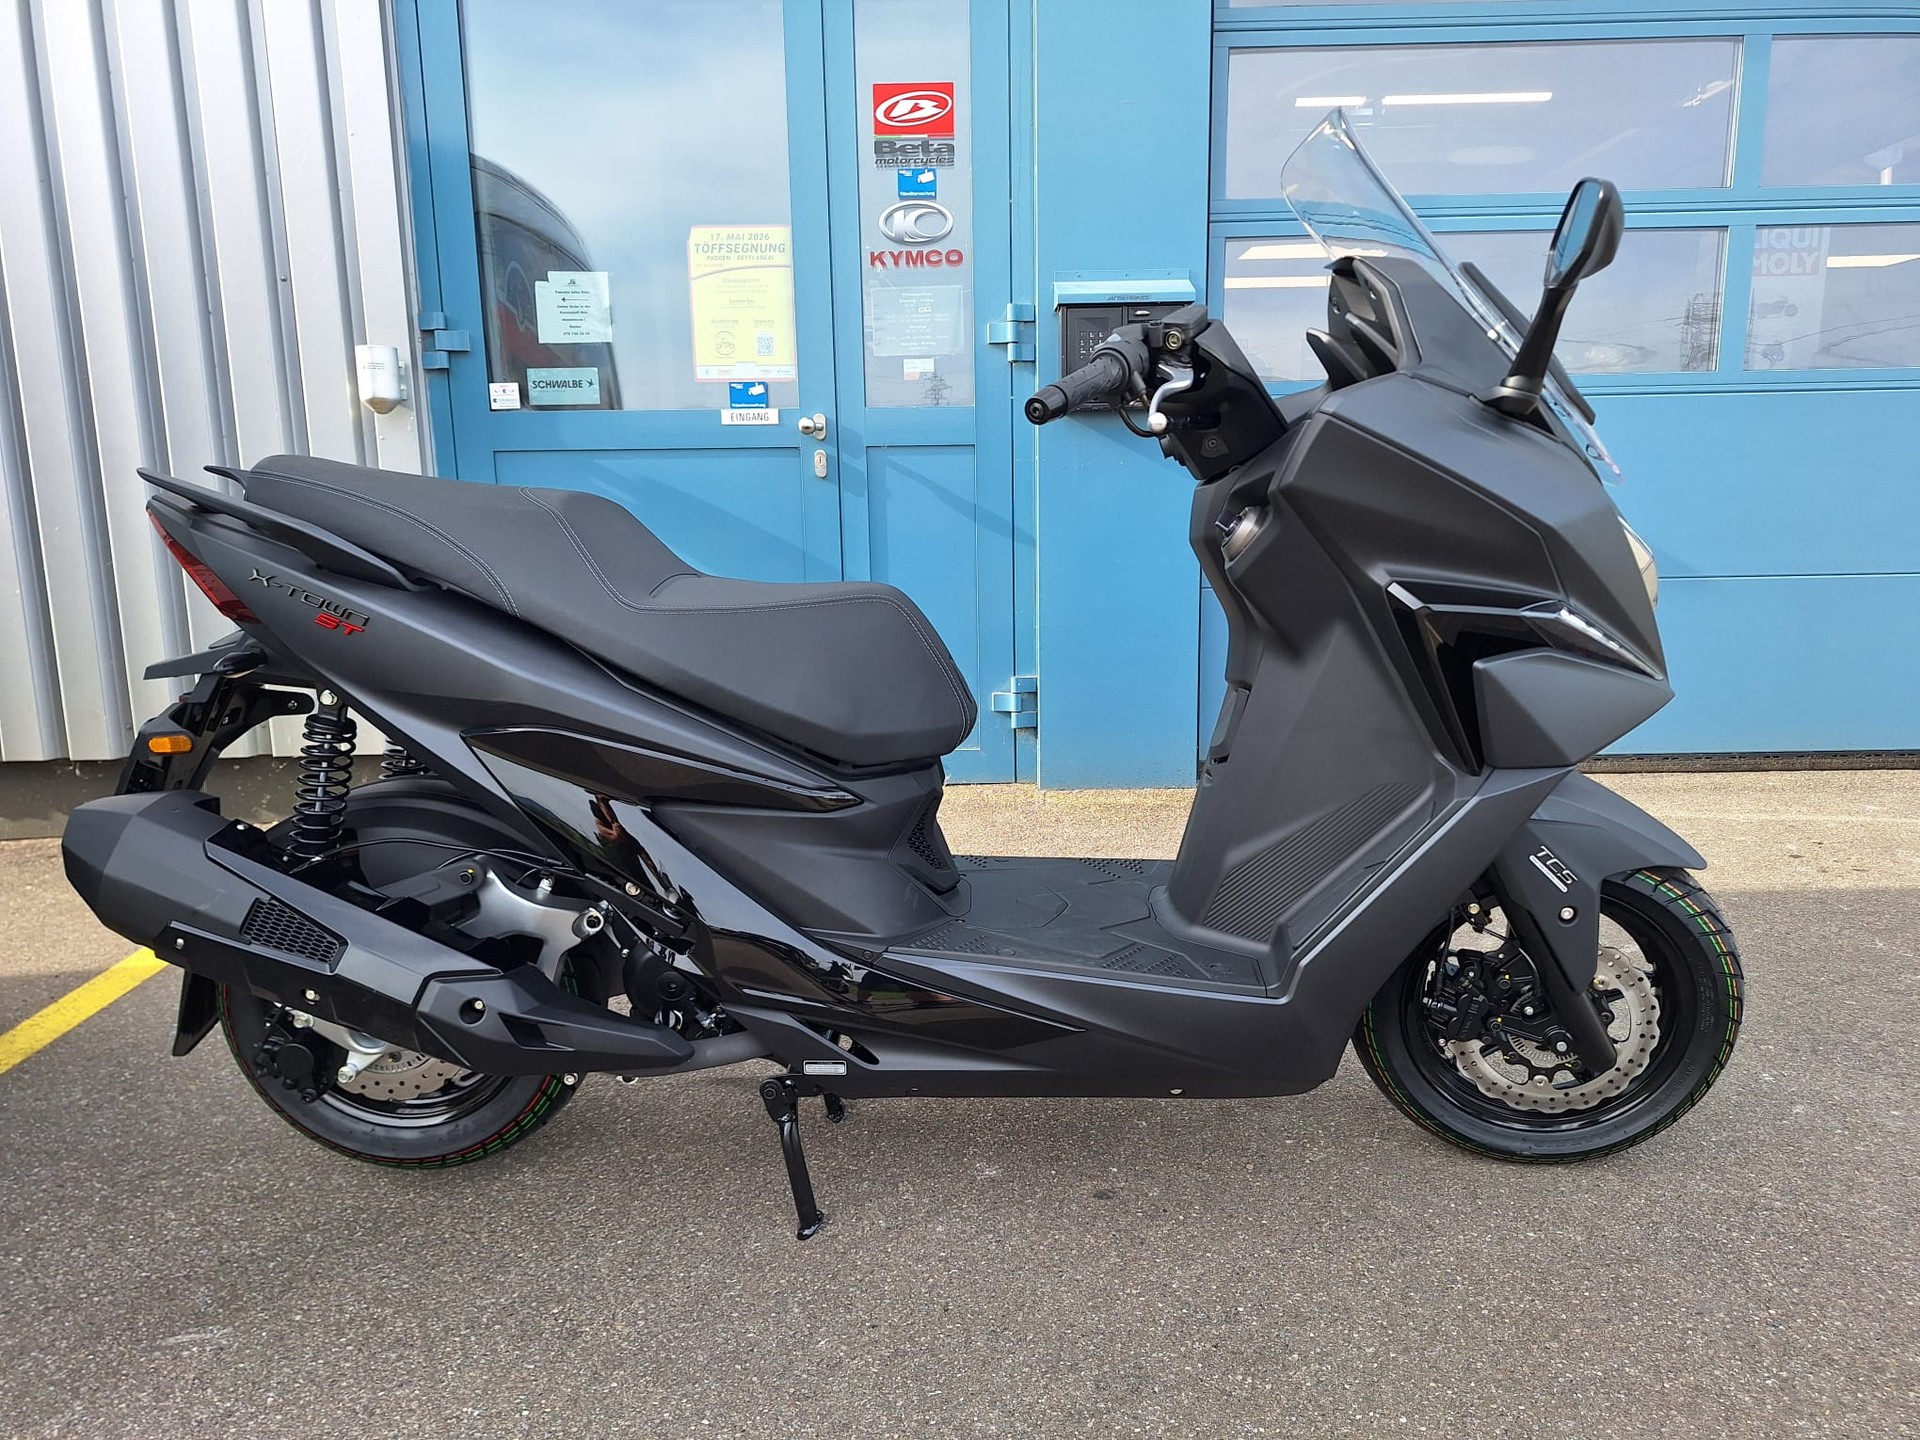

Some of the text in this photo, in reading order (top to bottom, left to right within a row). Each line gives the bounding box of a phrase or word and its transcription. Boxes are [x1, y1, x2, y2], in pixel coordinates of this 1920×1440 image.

[874, 139, 955, 155] Beta
[875, 156, 955, 167] motorcycles
[710, 232, 770, 242] 17. MAI 2026
[694, 241, 786, 254] TÖFFSEGNUNG
[870, 249, 964, 267] KYMCO
[532, 379, 584, 389] SCHWALBE
[730, 412, 769, 422] EINGANG
[314, 613, 366, 635] ST
[1536, 845, 1579, 884] TCS
